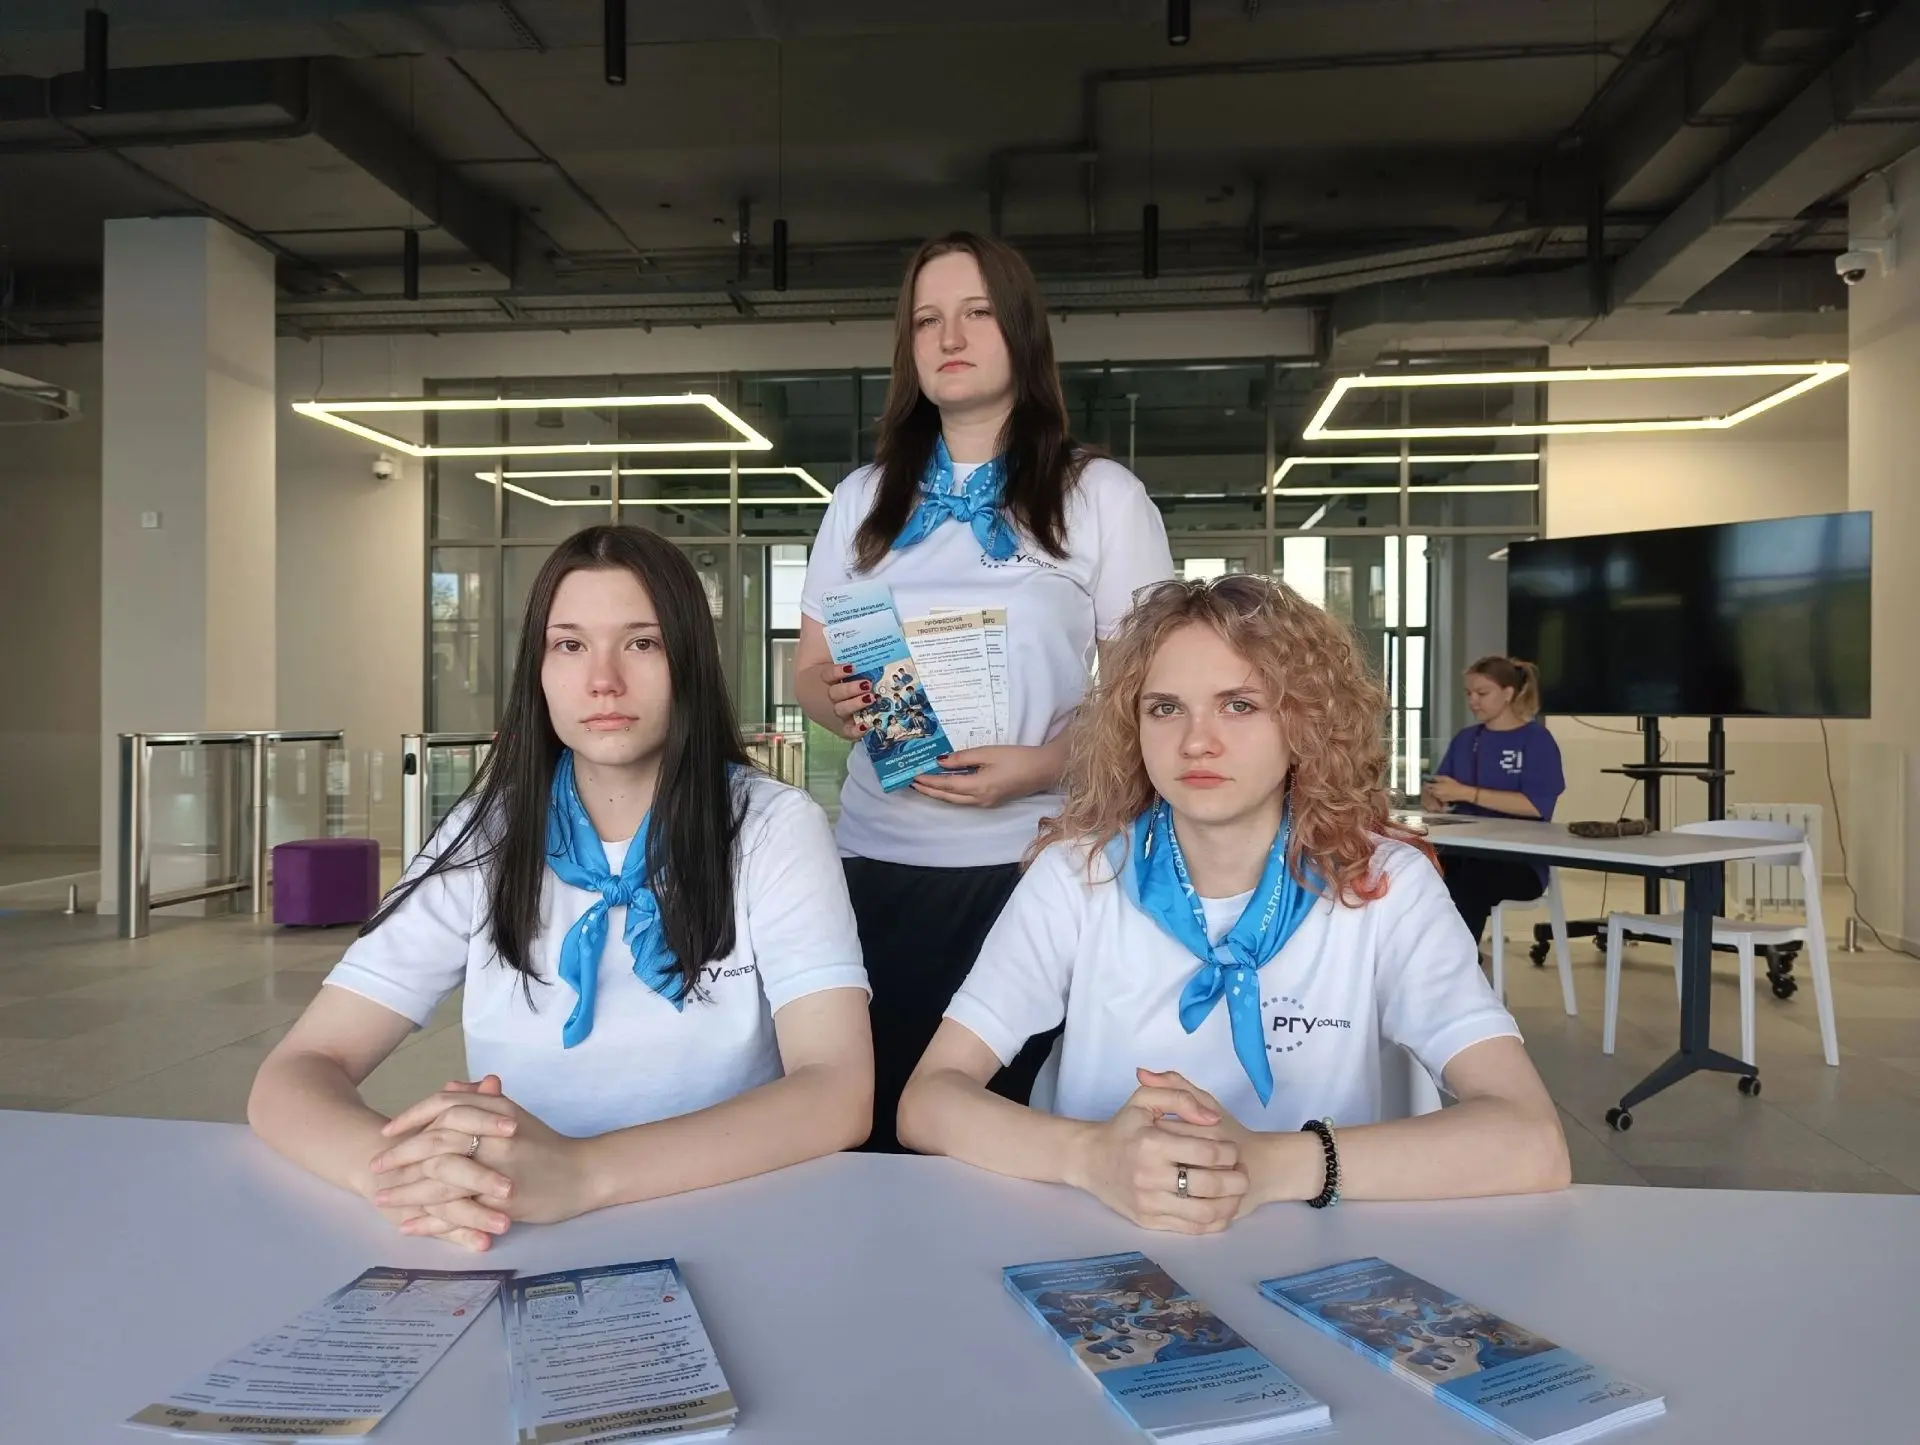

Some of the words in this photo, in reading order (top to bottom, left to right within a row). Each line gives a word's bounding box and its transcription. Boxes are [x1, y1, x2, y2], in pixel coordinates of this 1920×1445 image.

[697, 967, 722, 983] ГУ
[1272, 1016, 1317, 1034] РГУ
[1317, 1019, 1352, 1029] СОЦТЕХ
[1260, 1388, 1286, 1400] РГУ
[651, 1399, 708, 1414] ТВОЕГО
[564, 1409, 649, 1429] БУДУЩЕГО
[589, 1412, 687, 1434] ПРОФЕССИЯ
